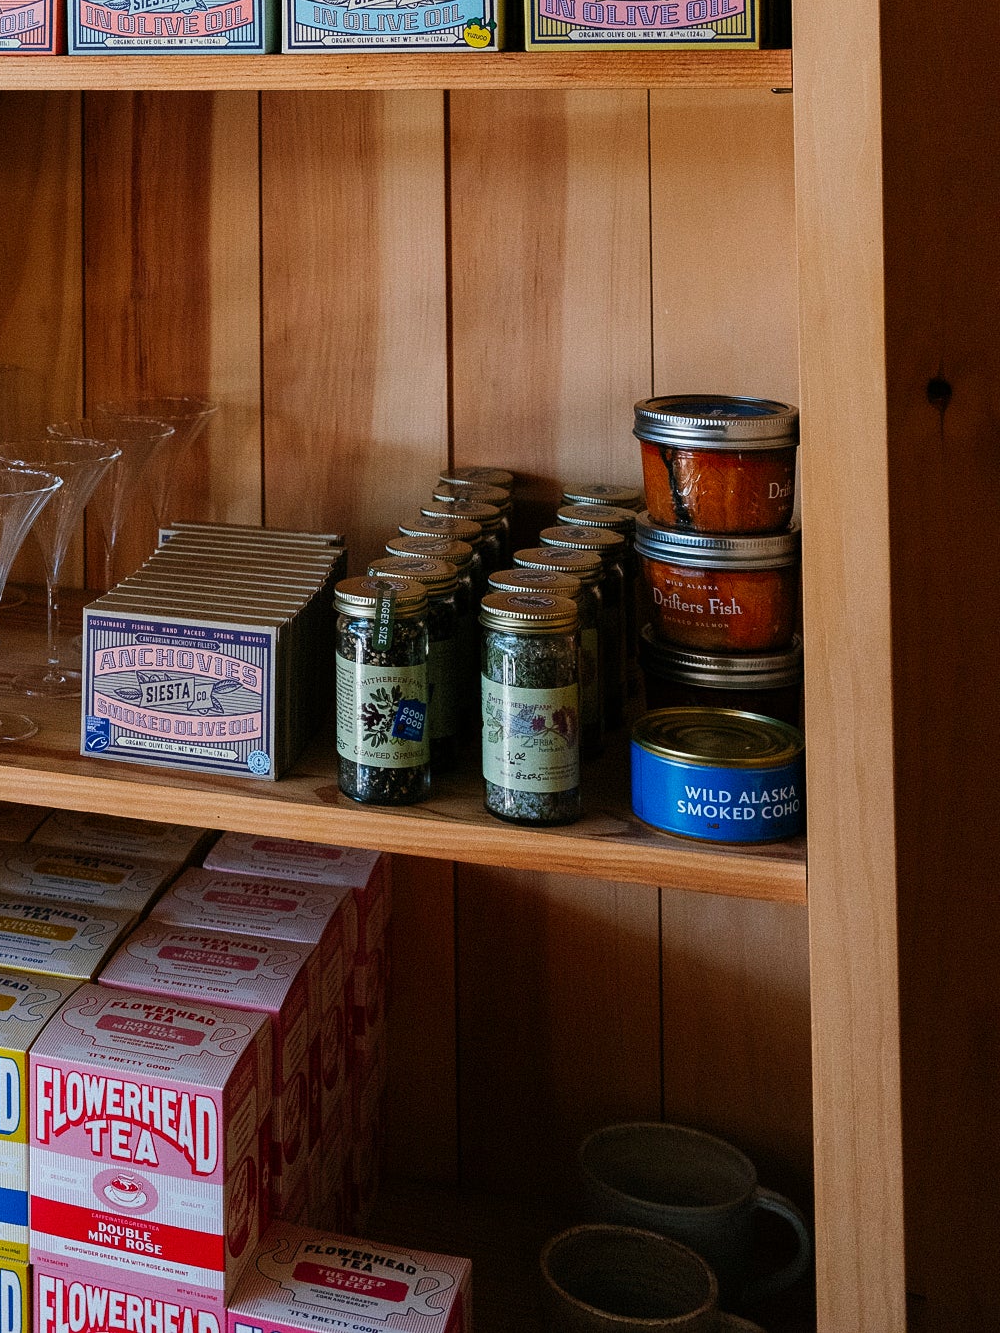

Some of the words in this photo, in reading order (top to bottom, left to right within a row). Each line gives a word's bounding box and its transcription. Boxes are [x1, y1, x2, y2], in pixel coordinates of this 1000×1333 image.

[0, 9, 40, 34] OIL
[86, 6, 112, 30] IN
[118, 14, 198, 35] OLIVE
[205, 6, 248, 32] OIL
[313, 5, 338, 27] IN
[343, 12, 419, 31] OLIVE
[424, 4, 464, 27] OIL
[583, 2, 679, 26] OLIVE
[666, 579, 683, 587] WILD
[687, 583, 719, 591] ALASKA
[653, 587, 704, 614] Drifters
[709, 597, 743, 615] Fish
[139, 635, 171, 645] CANTABRIAN
[171, 638, 198, 648] ANCHOVY
[198, 642, 217, 650] FILLETS
[378, 626, 389, 645] SIZE
[100, 648, 258, 687] ANCHOVIES
[146, 682, 190, 703] SIESTA
[97, 697, 172, 733] SMOKED
[174, 719, 227, 737] OLIVE
[228, 717, 259, 734] OIL
[399, 714, 423, 730] FOOD
[403, 706, 424, 722] GOOD
[685, 786, 732, 803] WILD
[739, 785, 796, 804] ALASKA
[677, 800, 756, 820] SMOKED
[762, 799, 800, 819] COHO
[36, 1065, 218, 1176] FLOWERHEAD
[84, 1120, 159, 1165] TEA
[98, 1222, 152, 1242] DOUBLE
[88, 1230, 120, 1246] MINT
[125, 1237, 163, 1256] ROSE
[318, 1269, 345, 1279] THE
[350, 1275, 386, 1287] DEEP
[325, 1276, 372, 1291] STEEP
